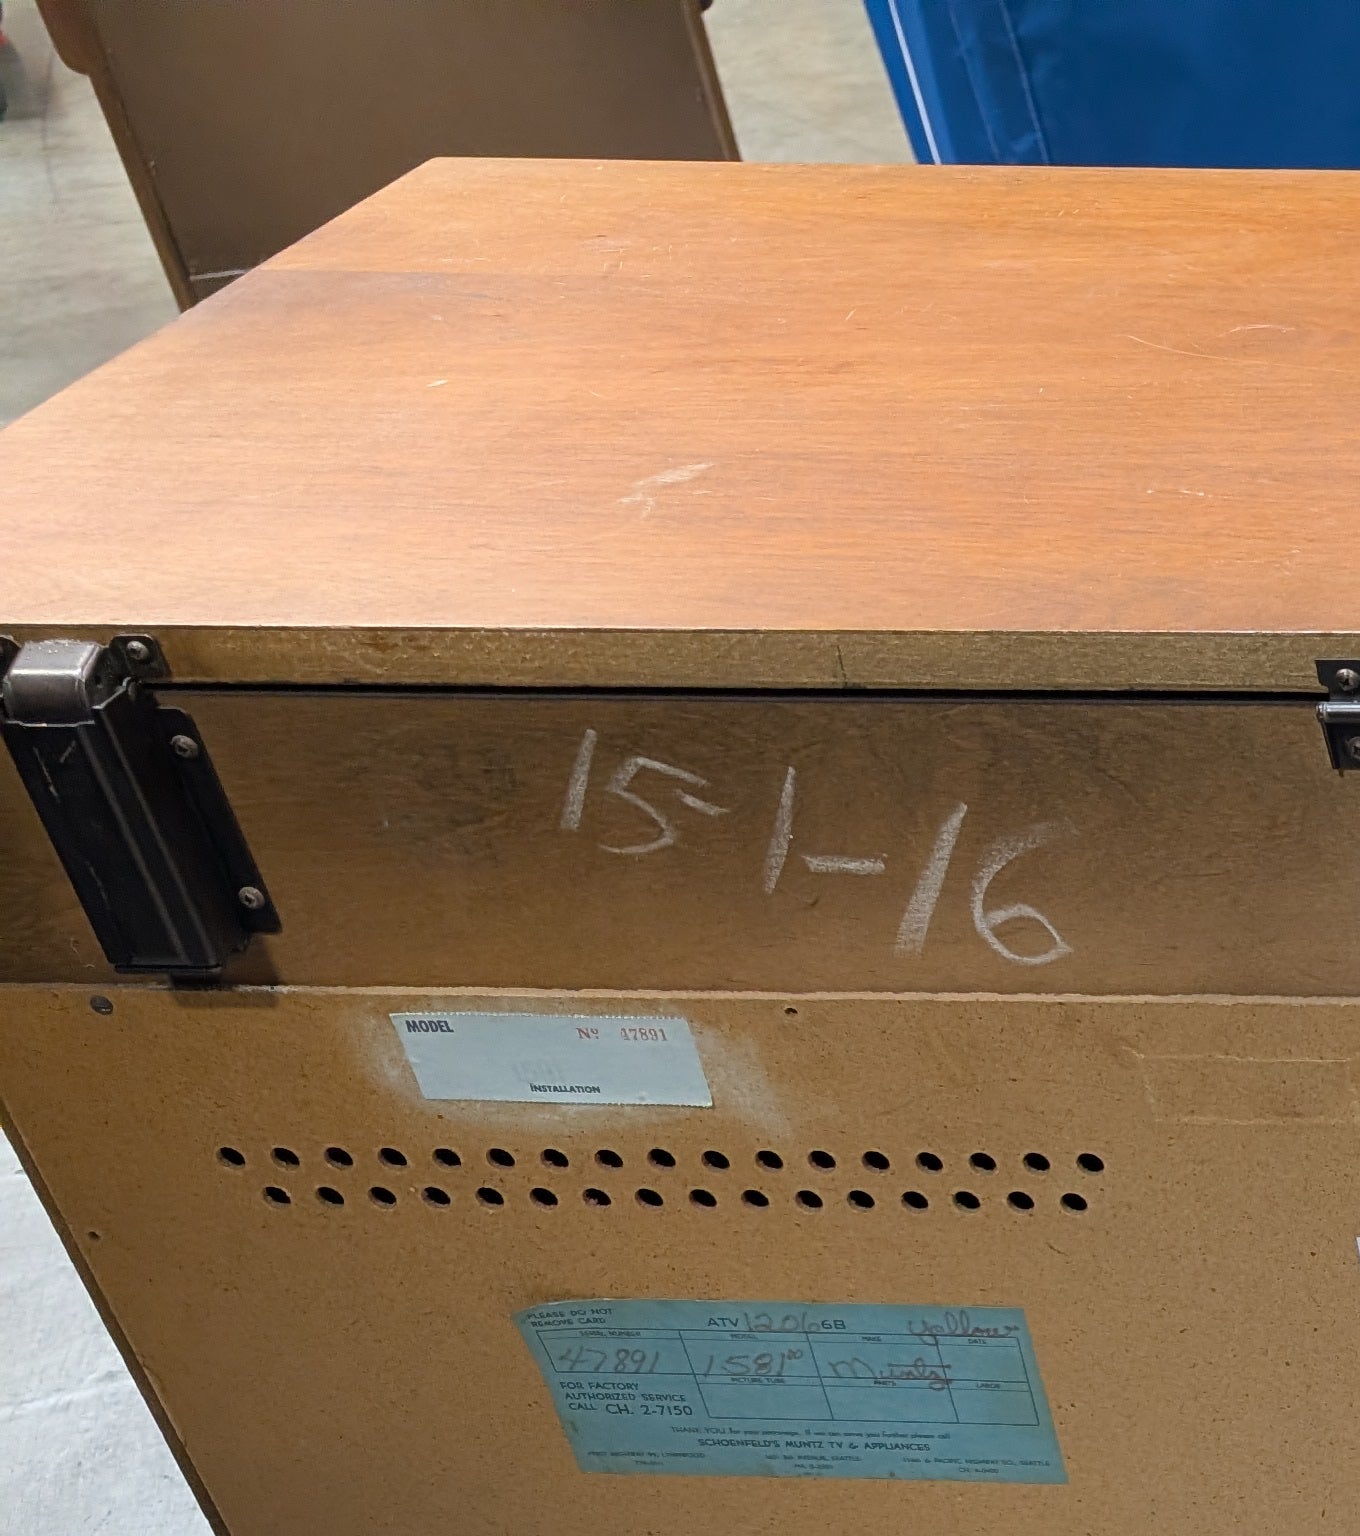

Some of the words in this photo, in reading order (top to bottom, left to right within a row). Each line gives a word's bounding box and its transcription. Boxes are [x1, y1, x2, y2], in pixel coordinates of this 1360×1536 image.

[405, 1020, 455, 1033] MODEL
[529, 1082, 601, 1094] INSTALLATION
[527, 1311, 566, 1321] PLEASE
[591, 1308, 613, 1316] NOT
[530, 1319, 575, 1328] REMOVE
[577, 1317, 606, 1325] CARD
[707, 1317, 739, 1327] ATV
[560, 1382, 584, 1390] FOR
[588, 1382, 639, 1391] FACTORY
[565, 1392, 637, 1402] AUTHORIZED
[640, 1394, 687, 1402] SERVICE
[568, 1402, 599, 1411] CALL
[643, 1405, 693, 1417] 2-7150
[698, 1438, 781, 1448] SCHOENFELD'S
[785, 1440, 825, 1449] MUNTZ
[828, 1441, 843, 1449] TV
[864, 1443, 931, 1452] APPLIANCES
